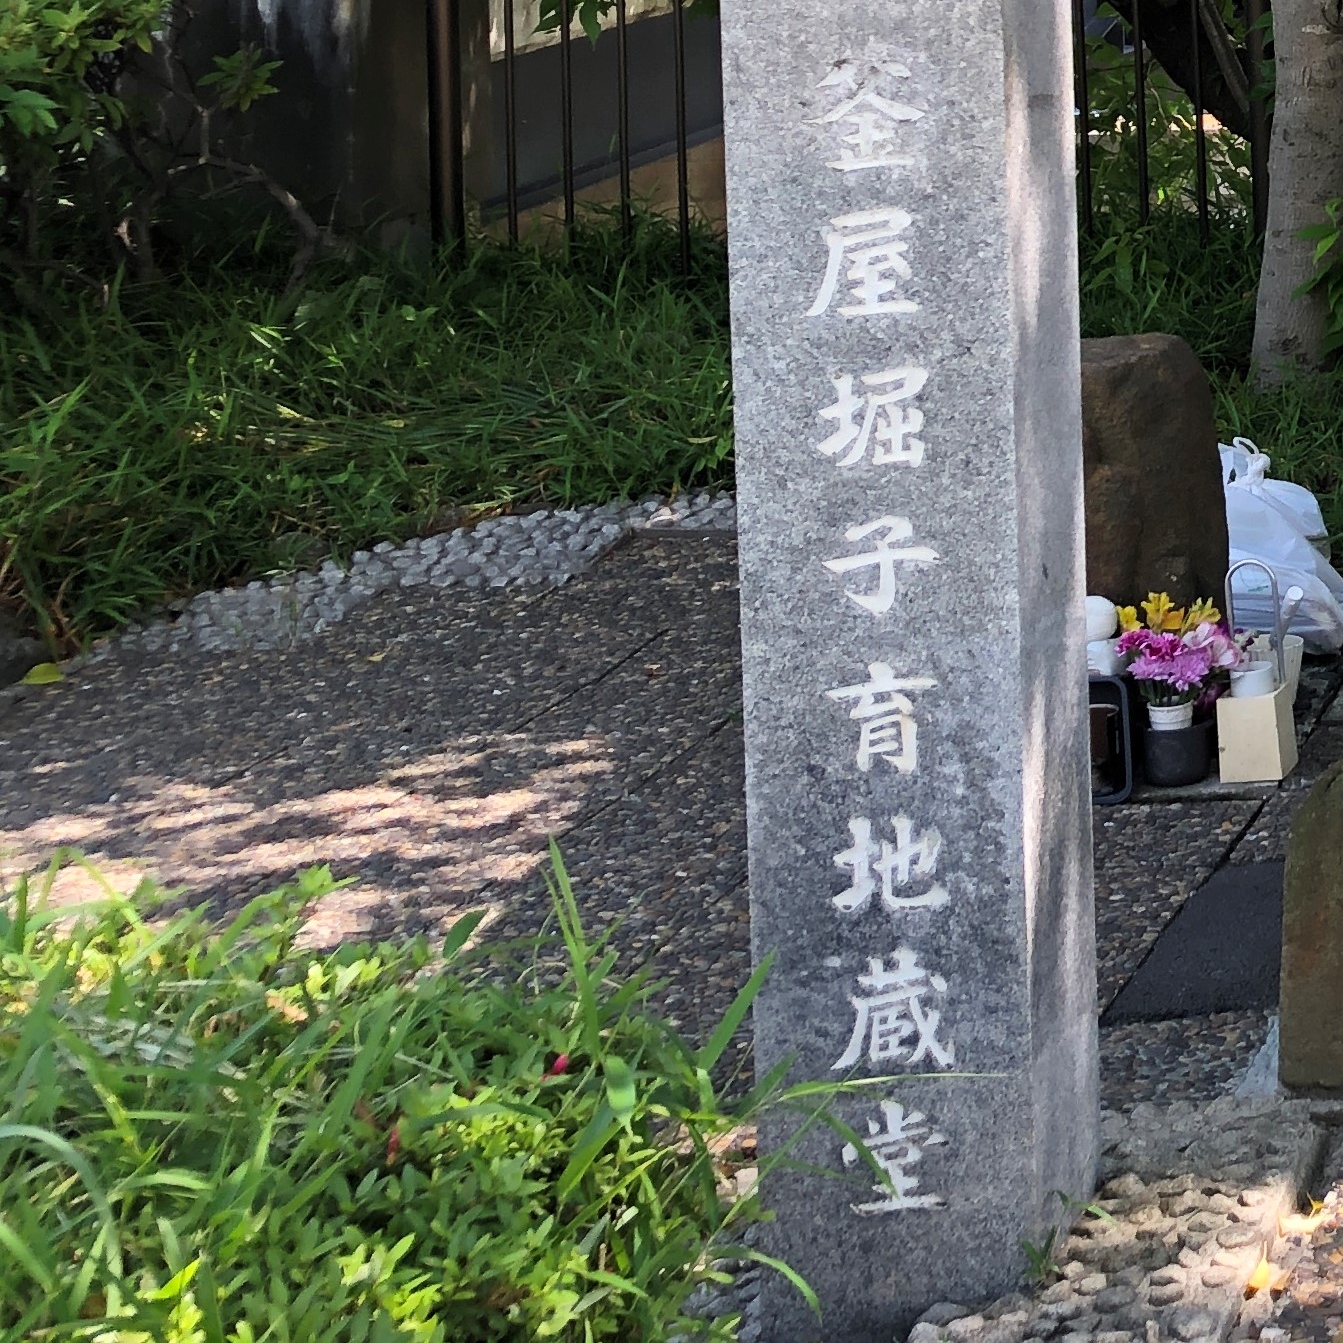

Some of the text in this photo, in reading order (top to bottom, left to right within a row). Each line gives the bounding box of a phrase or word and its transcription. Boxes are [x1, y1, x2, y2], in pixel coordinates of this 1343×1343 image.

[803, 46, 956, 1220] 釜屋堀子育地蔵堂
